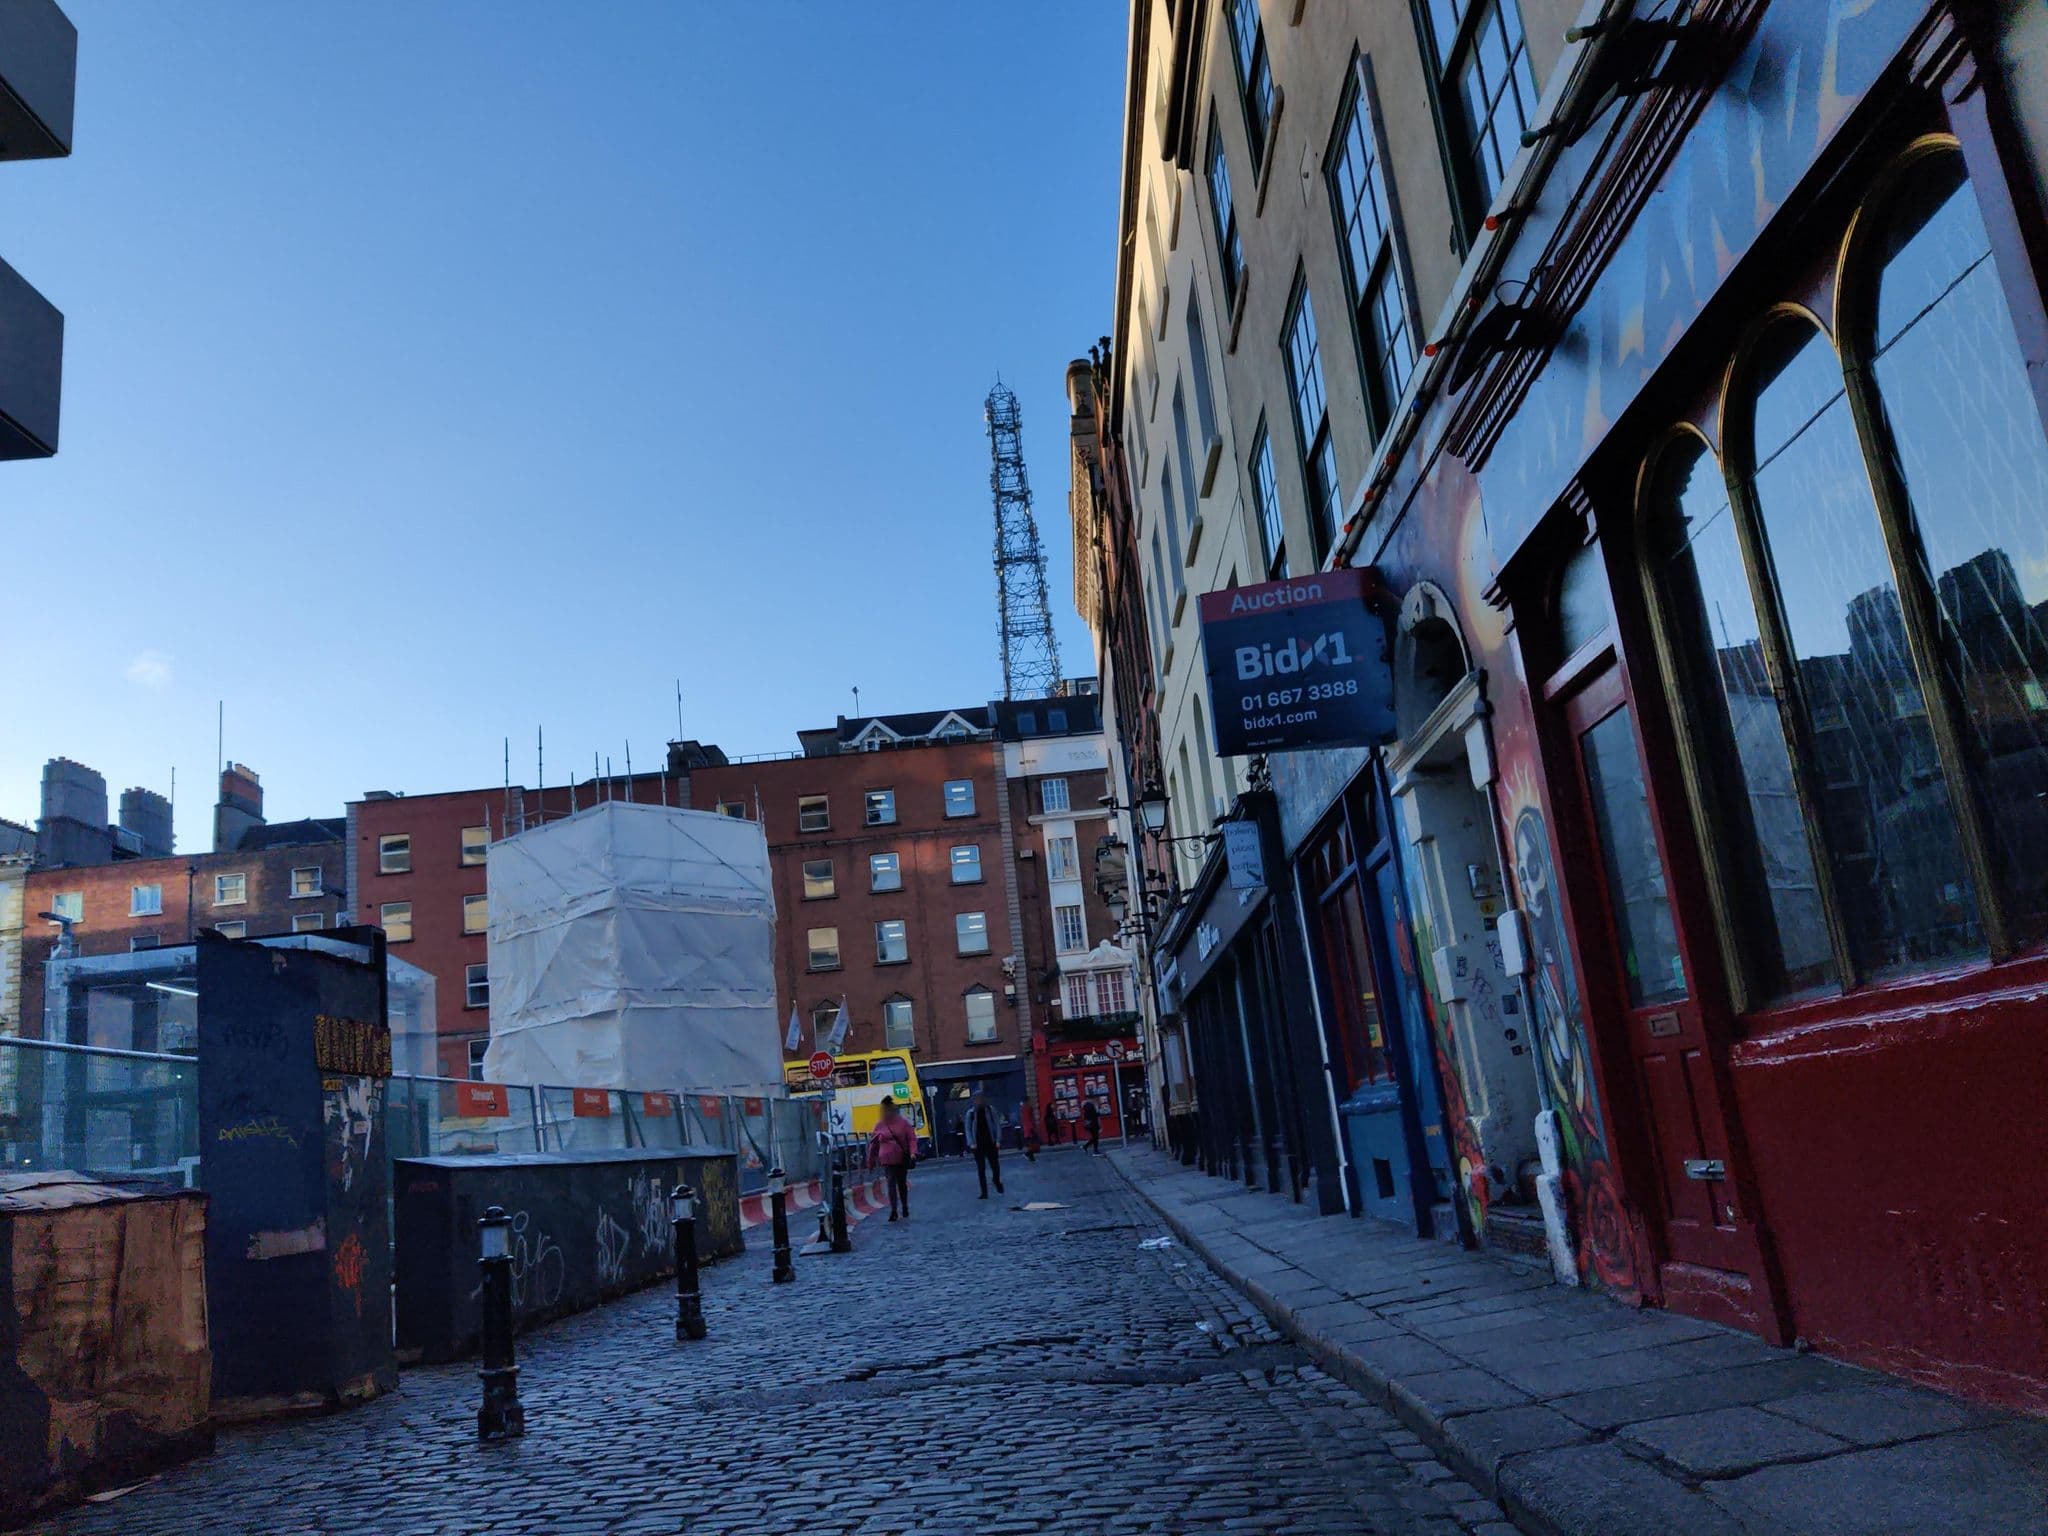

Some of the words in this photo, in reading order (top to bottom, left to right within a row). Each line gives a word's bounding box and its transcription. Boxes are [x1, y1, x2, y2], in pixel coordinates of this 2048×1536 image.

[1230, 583, 1323, 613] Auction
[1241, 694, 1263, 711] 01
[1267, 687, 1303, 707] 667
[1308, 679, 1358, 701] 3388
[1243, 710, 1318, 730] bidx1.com
[811, 1059, 831, 1071] STOP
[895, 1087, 908, 1095] TFI
